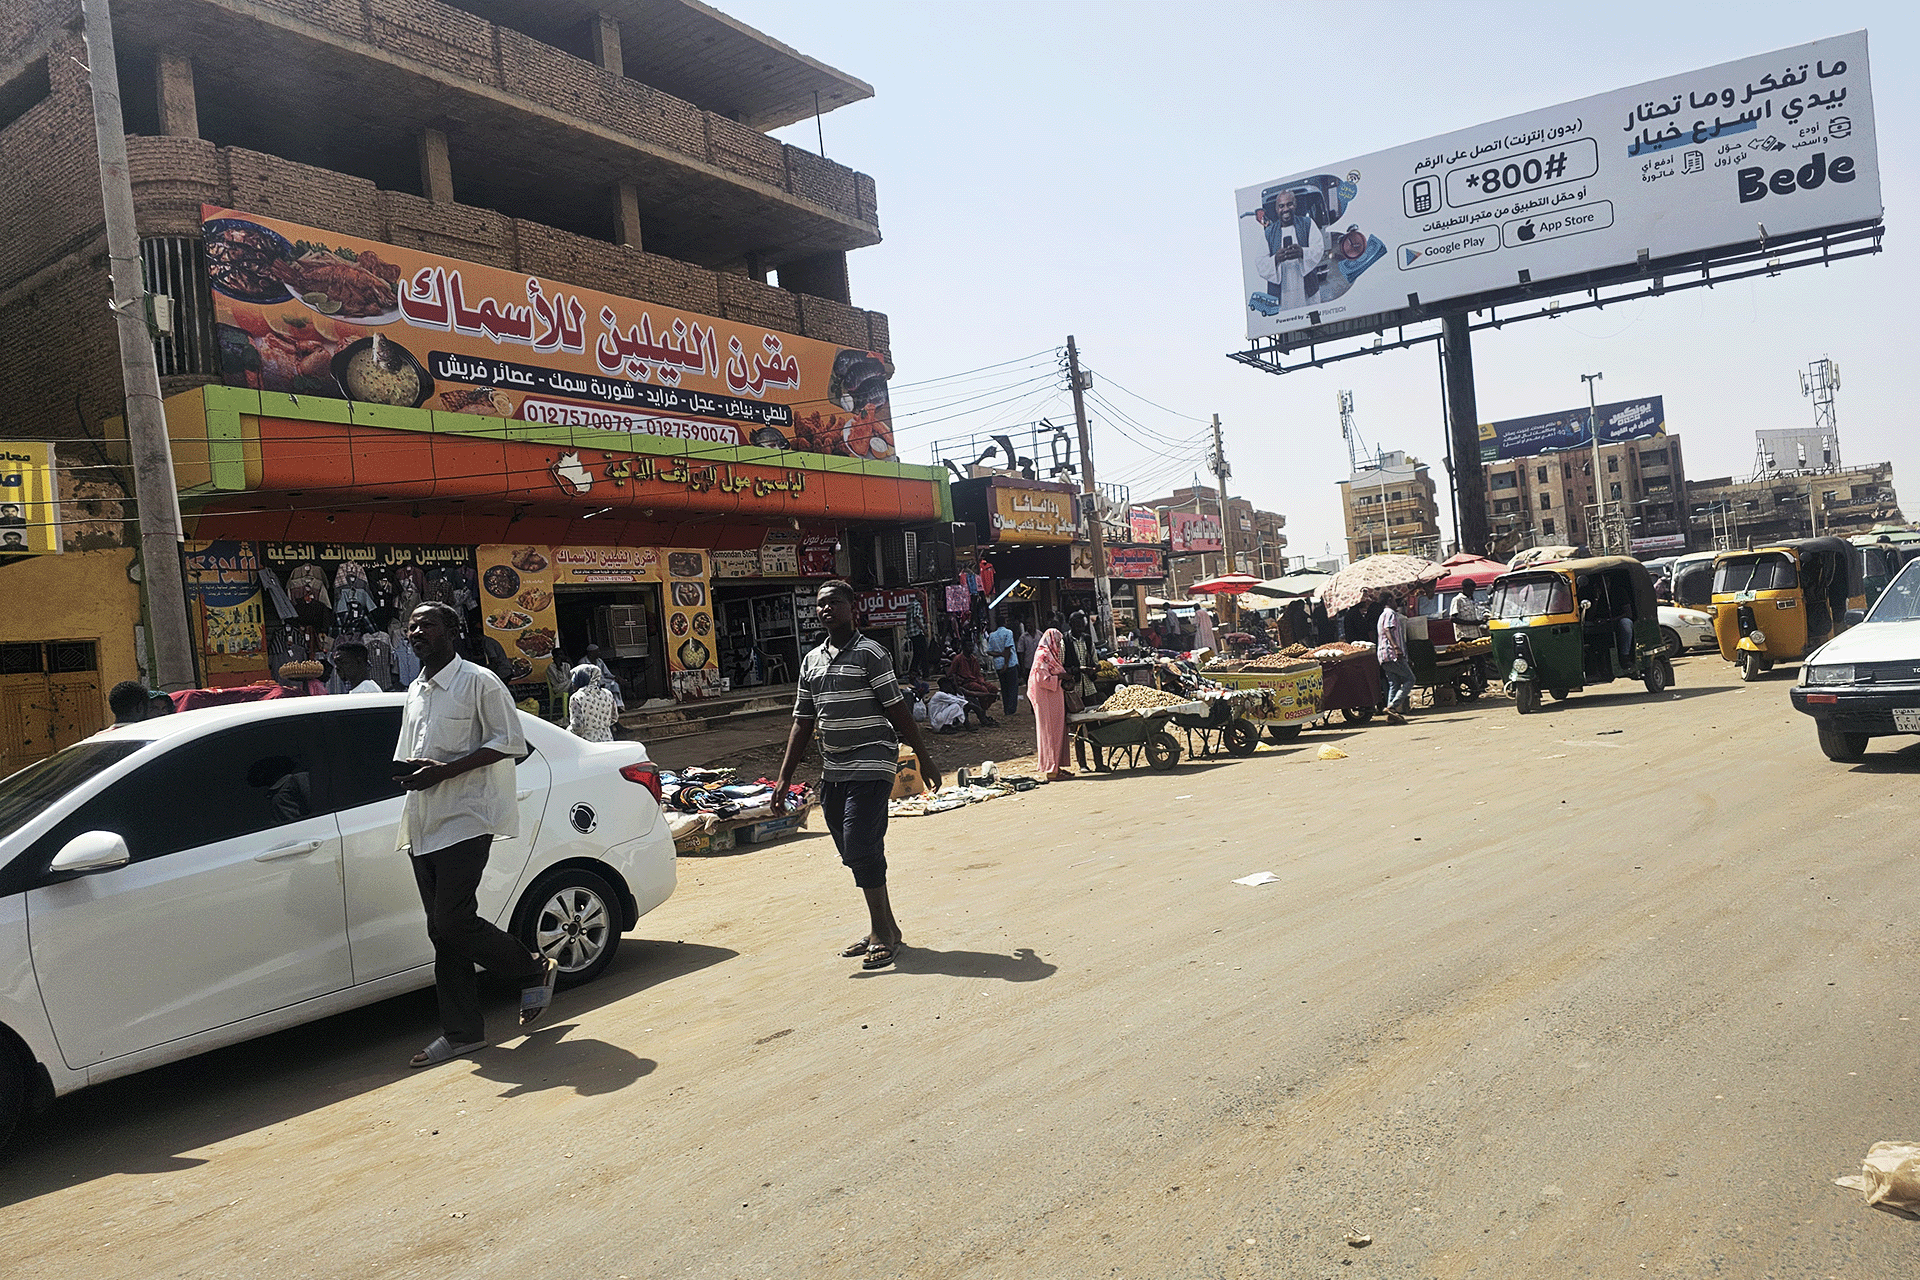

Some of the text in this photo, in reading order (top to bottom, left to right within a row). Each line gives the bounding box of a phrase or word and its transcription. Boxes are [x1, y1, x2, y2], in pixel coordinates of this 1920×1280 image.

[1817, 60, 1847, 78] ما
[1741, 64, 1808, 104] تفكر
[1623, 95, 1682, 131] تحتار
[1781, 87, 1847, 125] بيدي
[1629, 121, 1682, 155] خيار
[1799, 122, 1820, 137] أودع
[1446, 150, 1468, 164] على
[1469, 140, 1502, 158] اتصل
[1414, 154, 1444, 174] الرقم
[1642, 168, 1675, 183] فاتورة
[1738, 152, 1856, 204] Bede
[1577, 185, 1587, 200] أو
[1494, 206, 1509, 218] من
[1511, 197, 1549, 214] التطبيق
[1422, 215, 1469, 232] التطبيقات
[1469, 210, 1493, 224] متجر
[1539, 212, 1595, 233] App Store
[1424, 236, 1485, 257] Google Play
[1275, 315, 1297, 324] Powered
[398, 266, 800, 398] مقرن النيلين للأسماك
[438, 353, 488, 381] فريش
[492, 364, 535, 386] عصائر
[549, 372, 587, 393] سمك
[591, 378, 635, 401] شوربة
[647, 390, 678, 408] فرايد
[689, 394, 715, 413] عجل
[763, 404, 788, 423] بلطي
[721, 465, 751, 492] مول
[267, 543, 316, 565] الذكية
[385, 546, 412, 565] مول
[557, 546, 597, 566] للأسماك
[634, 550, 657, 567] مقرن
[858, 592, 884, 612] فون
